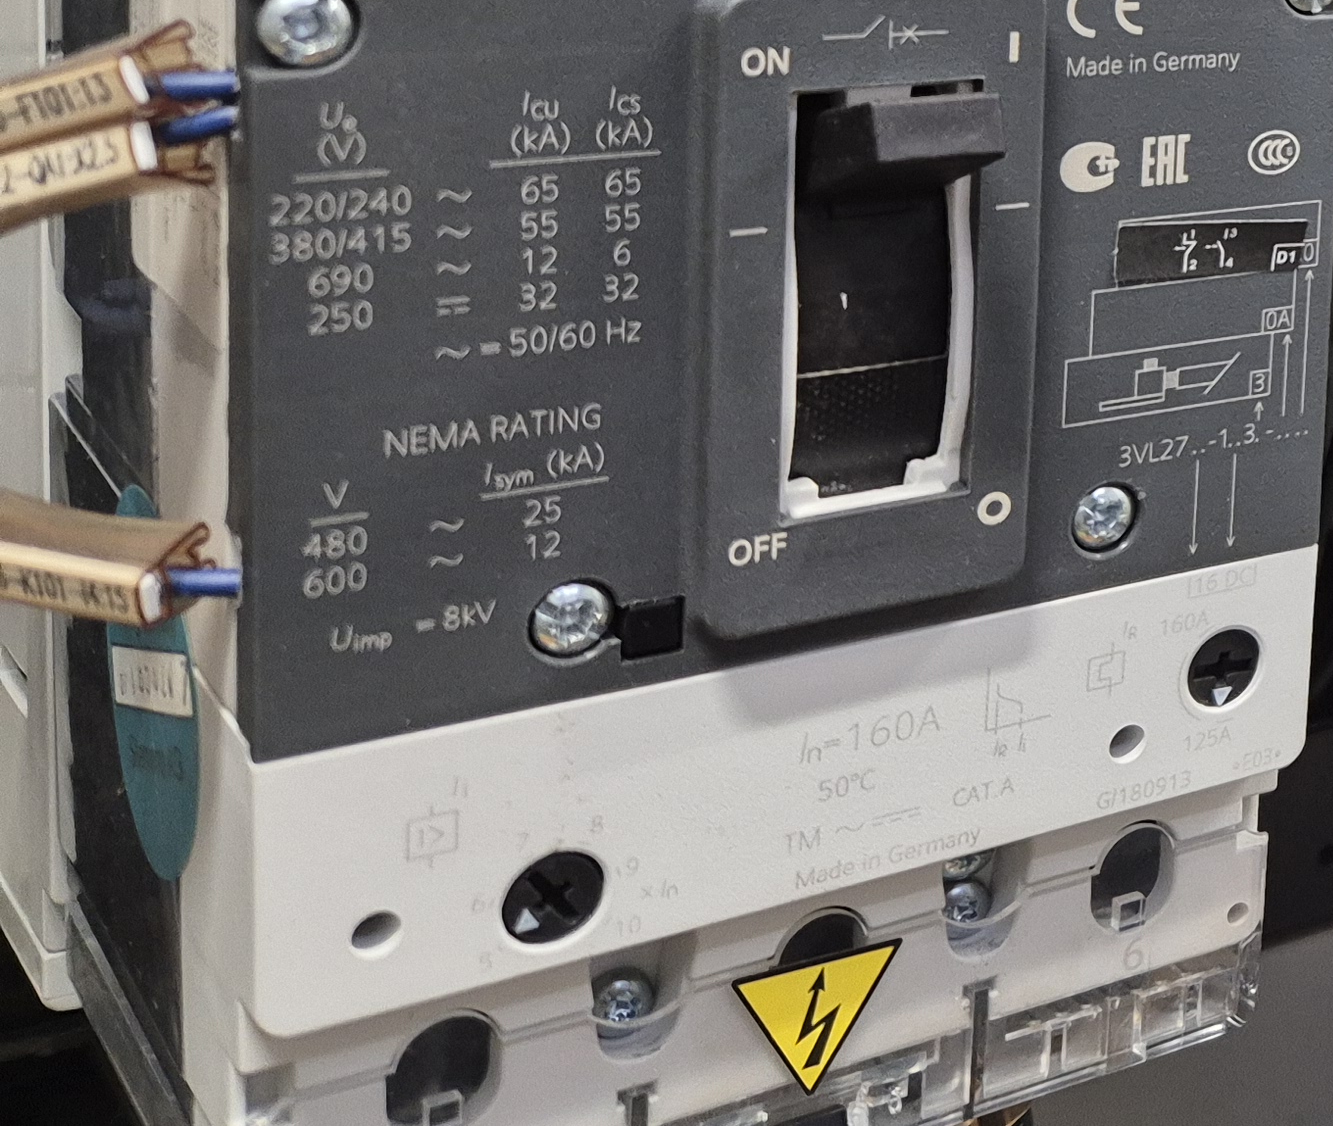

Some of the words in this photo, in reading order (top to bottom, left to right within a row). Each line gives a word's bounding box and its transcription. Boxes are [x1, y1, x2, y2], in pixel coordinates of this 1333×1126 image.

[739, 46, 792, 77] ON
[1065, 55, 1123, 80] Made
[1129, 52, 1149, 75] in
[1152, 48, 1242, 78] Germany
[316, 129, 368, 168] (V)
[509, 120, 572, 158] (kA)
[594, 115, 655, 151] (kA)
[268, 183, 413, 228] 220/240
[520, 173, 560, 206] 65
[603, 166, 642, 199] 65
[268, 219, 413, 265] 380/415
[519, 209, 560, 242] 55
[603, 201, 642, 234] 55
[307, 262, 375, 299] 690
[520, 244, 559, 276] 12
[612, 236, 632, 267] 6
[307, 298, 375, 337] 250
[518, 279, 559, 313] 32
[602, 271, 641, 303] 32
[507, 319, 597, 358] 50/60
[604, 317, 643, 347] Hz
[382, 417, 481, 460] NEMA
[488, 400, 603, 445] RATING
[545, 441, 606, 479] (kA)
[321, 478, 351, 510] V
[301, 524, 369, 562] 480
[520, 494, 563, 528] 25
[727, 531, 788, 567] OFF
[301, 561, 369, 601] 600
[524, 529, 563, 562] 12
[1095, 767, 1193, 811] G/180913
[794, 858, 856, 891] Made
[859, 851, 882, 874] in
[887, 826, 983, 867] Germany
[1123, 938, 1145, 970] 6
